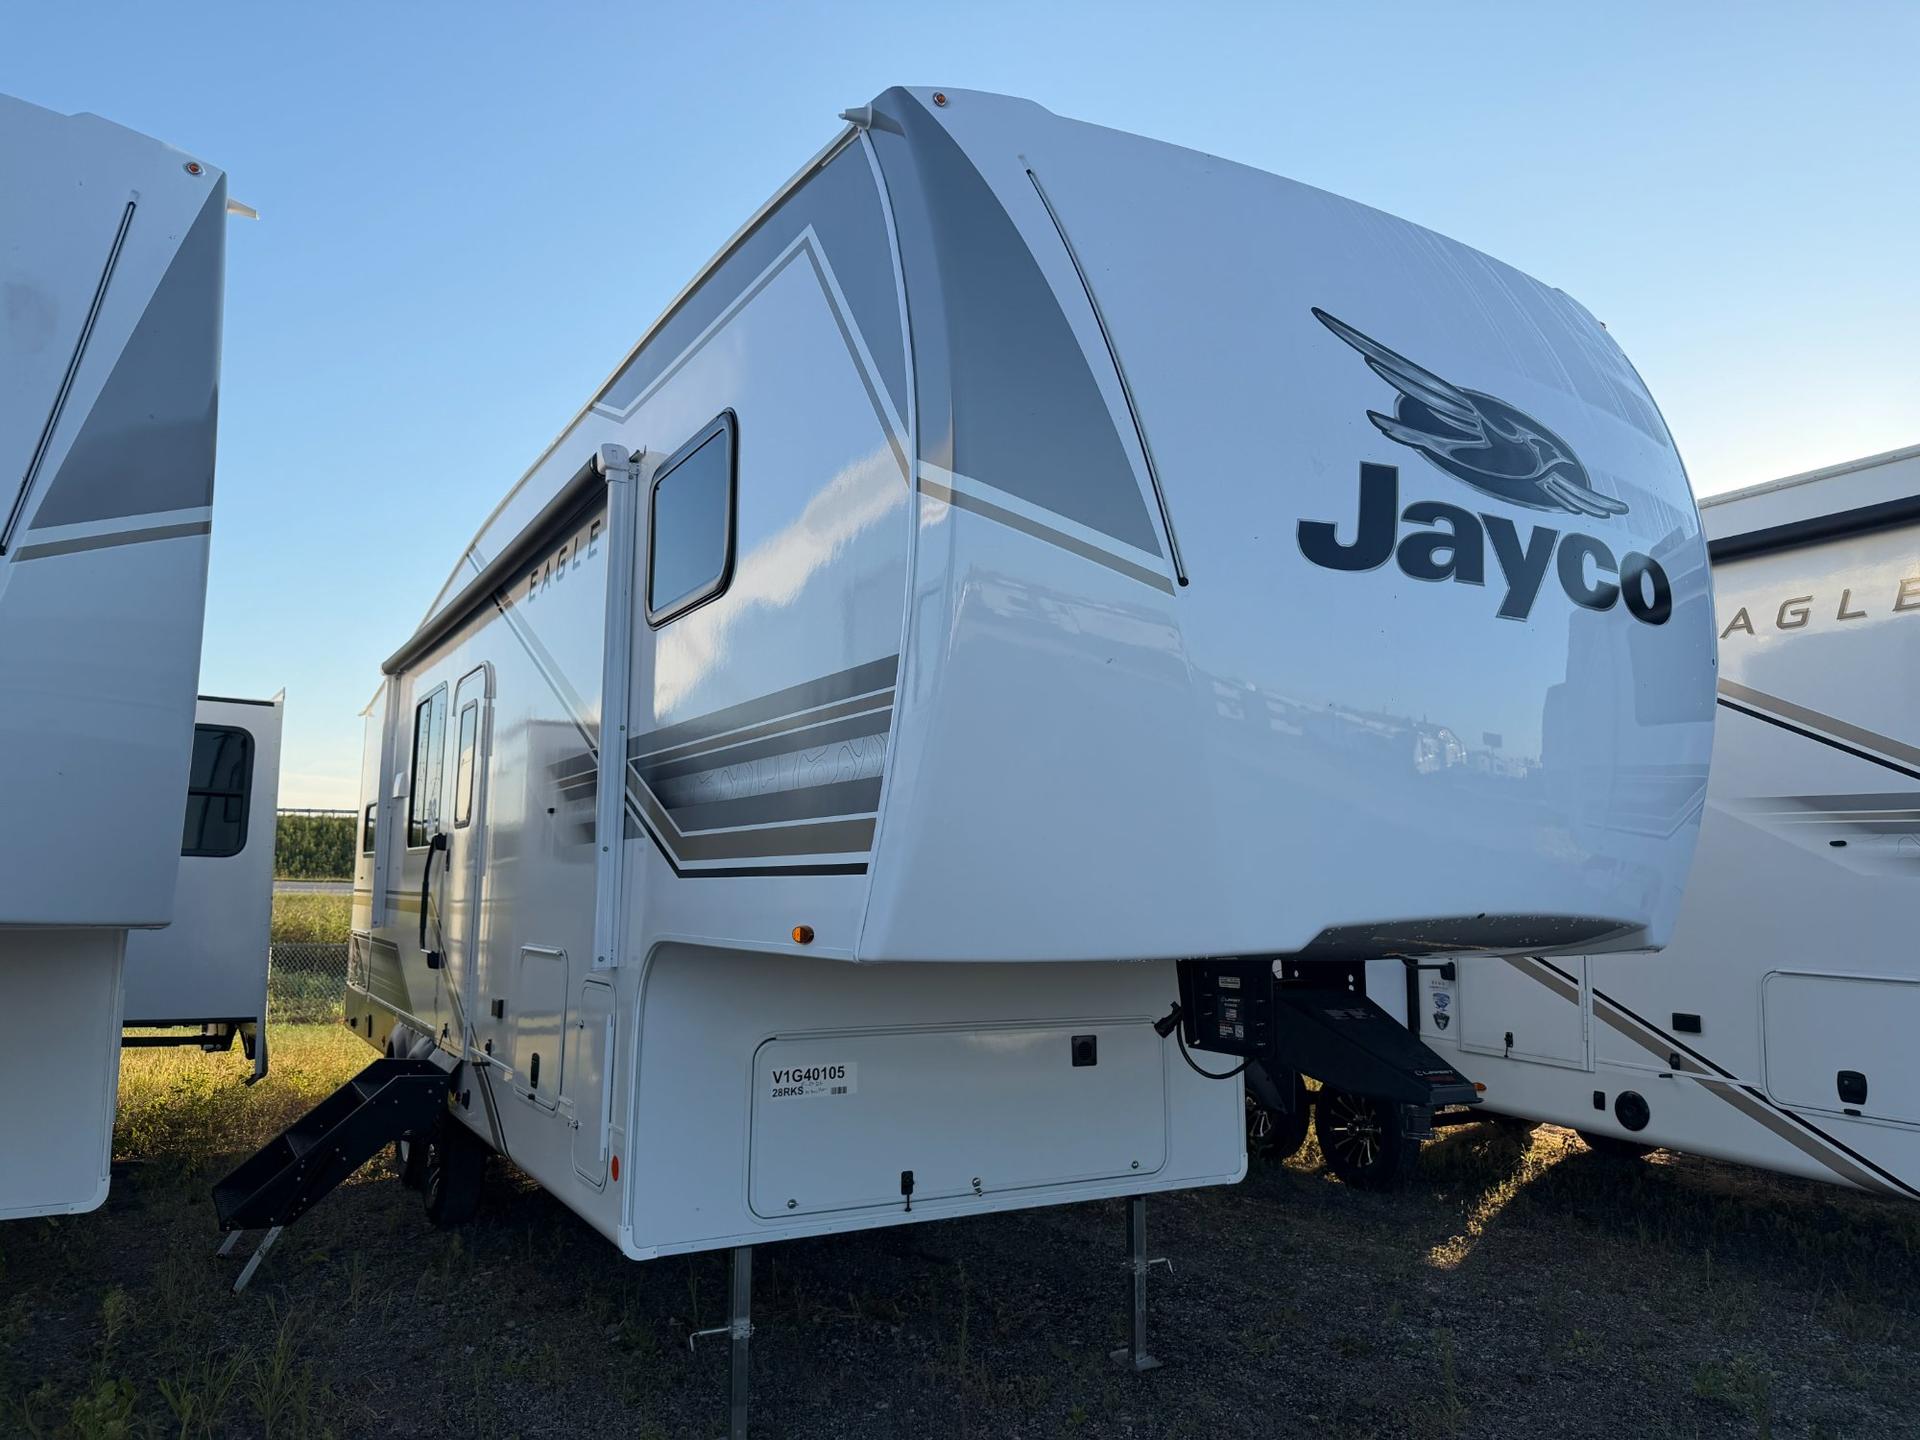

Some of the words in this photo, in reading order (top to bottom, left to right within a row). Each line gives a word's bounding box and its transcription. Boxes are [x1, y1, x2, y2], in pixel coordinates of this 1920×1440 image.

[528, 519, 601, 602] EAGLE
[1296, 461, 1673, 626] Jayco
[772, 1065, 845, 1084] V1G40105
[772, 1086, 804, 1098] 28RKS
